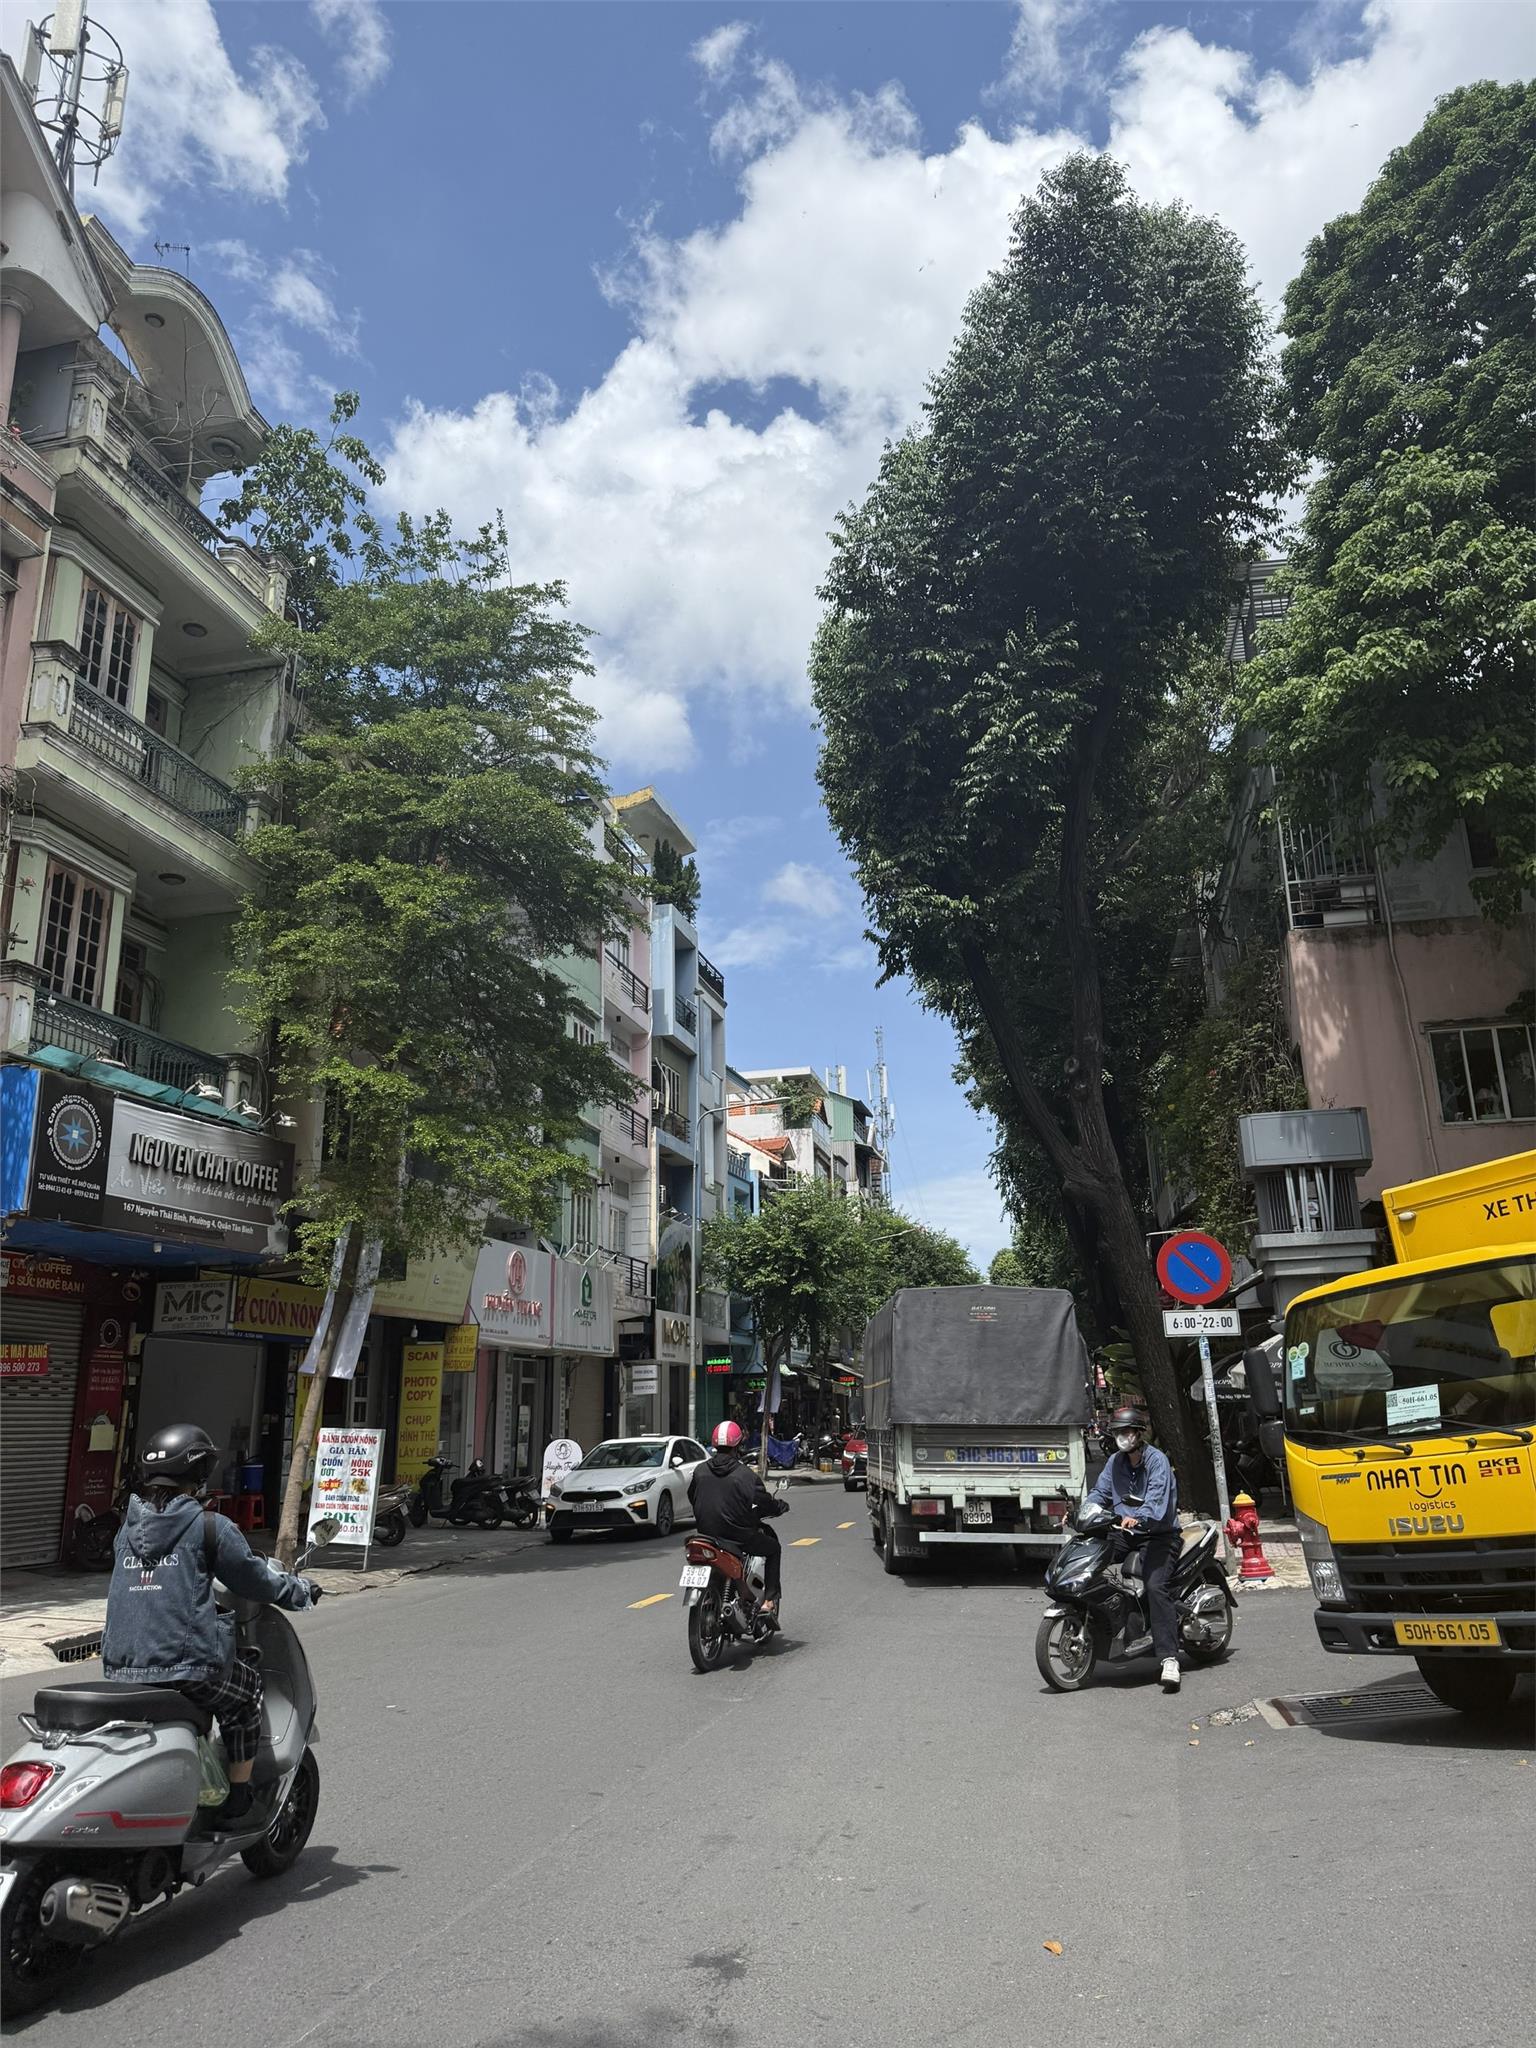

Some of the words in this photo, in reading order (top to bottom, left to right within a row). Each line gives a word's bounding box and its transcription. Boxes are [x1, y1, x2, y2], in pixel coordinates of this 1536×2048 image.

[130, 1134, 194, 1174] NGUYEN
[234, 1159, 279, 1192] COFFEE
[123, 1202, 135, 1212] 167
[1483, 1199, 1510, 1221] XE
[38, 1262, 73, 1275] COFFEE
[163, 1290, 225, 1314] MIC
[250, 1288, 287, 1326] CUỐN
[1173, 1316, 1233, 1329] 6:00-22:00
[407, 1351, 439, 1361] SCAN
[12, 1362, 26, 1372] 500
[27, 1362, 40, 1372] 273
[404, 1376, 437, 1387] PHOTO
[406, 1390, 434, 1401] COPY
[405, 1415, 432, 1426] CHỤP
[340, 1432, 359, 1444] CUỐN
[359, 1434, 377, 1444] NÓNG
[329, 1446, 345, 1455] GIA
[322, 1456, 343, 1467] CUỐN
[351, 1458, 373, 1468] NÓNG
[1477, 1456, 1520, 1469] QKR
[350, 1468, 371, 1477] 25K
[1366, 1466, 1421, 1491] NHAT
[1428, 1463, 1467, 1487] TIN
[1480, 1465, 1522, 1478] 210
[969, 1502, 984, 1512] 51C
[1409, 1499, 1457, 1513] logistics
[1388, 1513, 1465, 1537] ISUZU
[123, 1553, 179, 1569] CLASSICS
[1403, 1624, 1490, 1640] 50H-661.05
